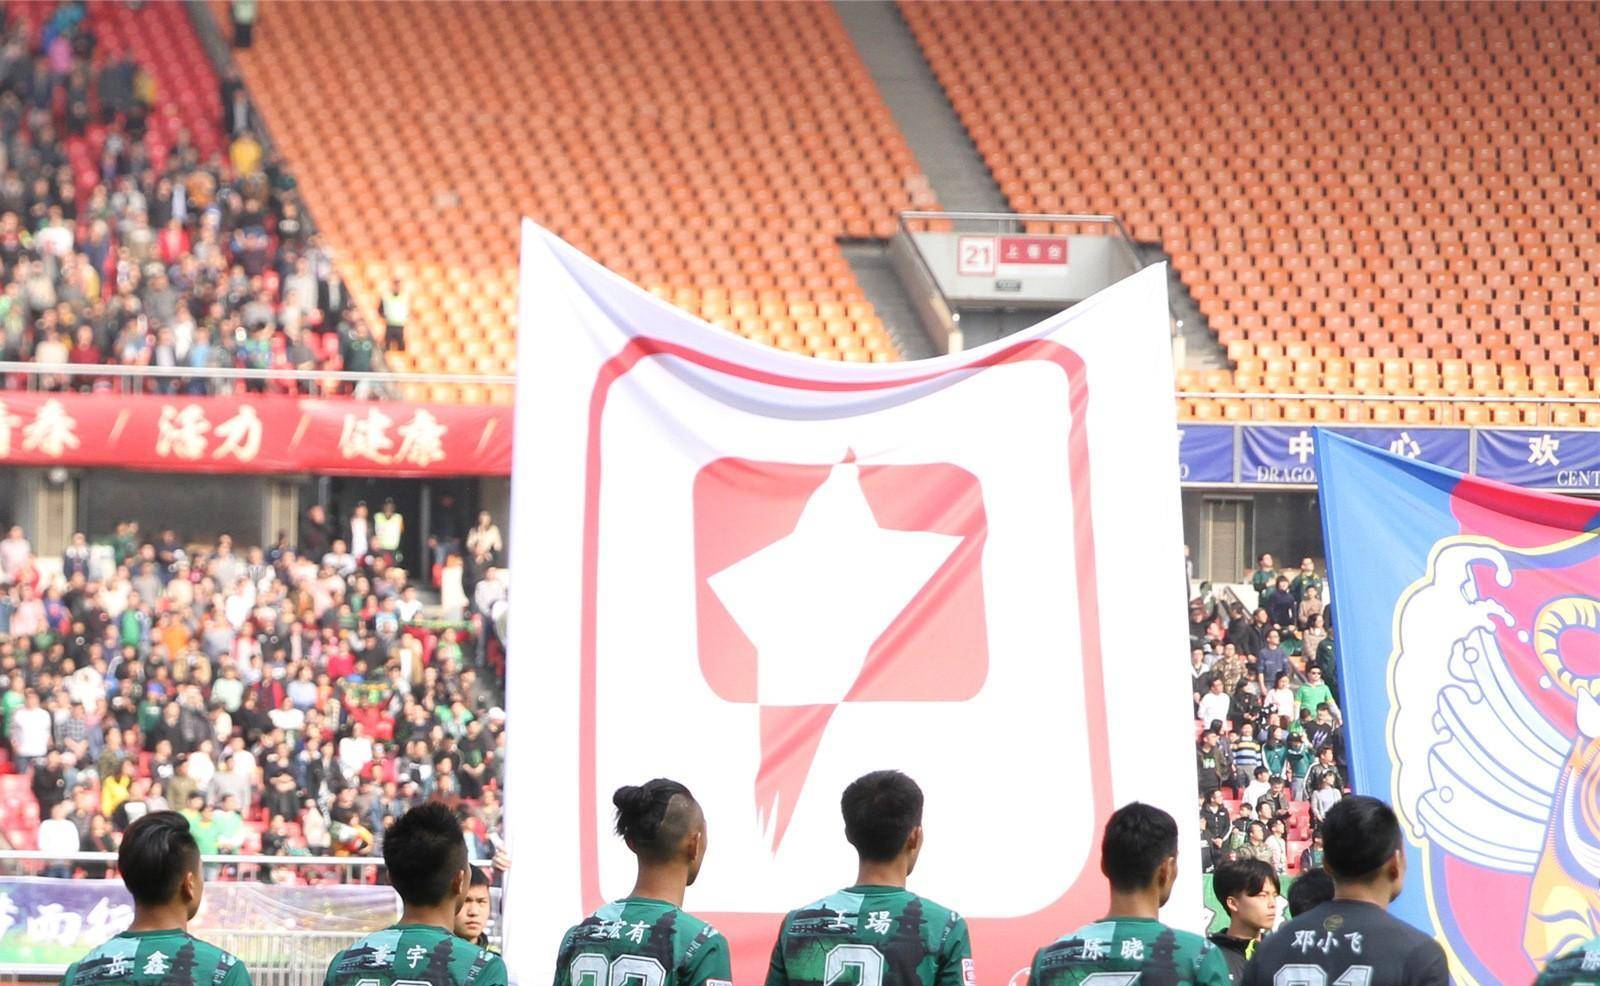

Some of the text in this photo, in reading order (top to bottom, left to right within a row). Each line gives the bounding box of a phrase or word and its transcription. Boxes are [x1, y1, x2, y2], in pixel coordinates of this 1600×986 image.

[965, 244, 990, 265] 21
[156, 403, 262, 461] 活力
[338, 406, 447, 467] 健康
[1257, 465, 1317, 482] DRAGO
[1290, 930, 1365, 955] 邓小飞
